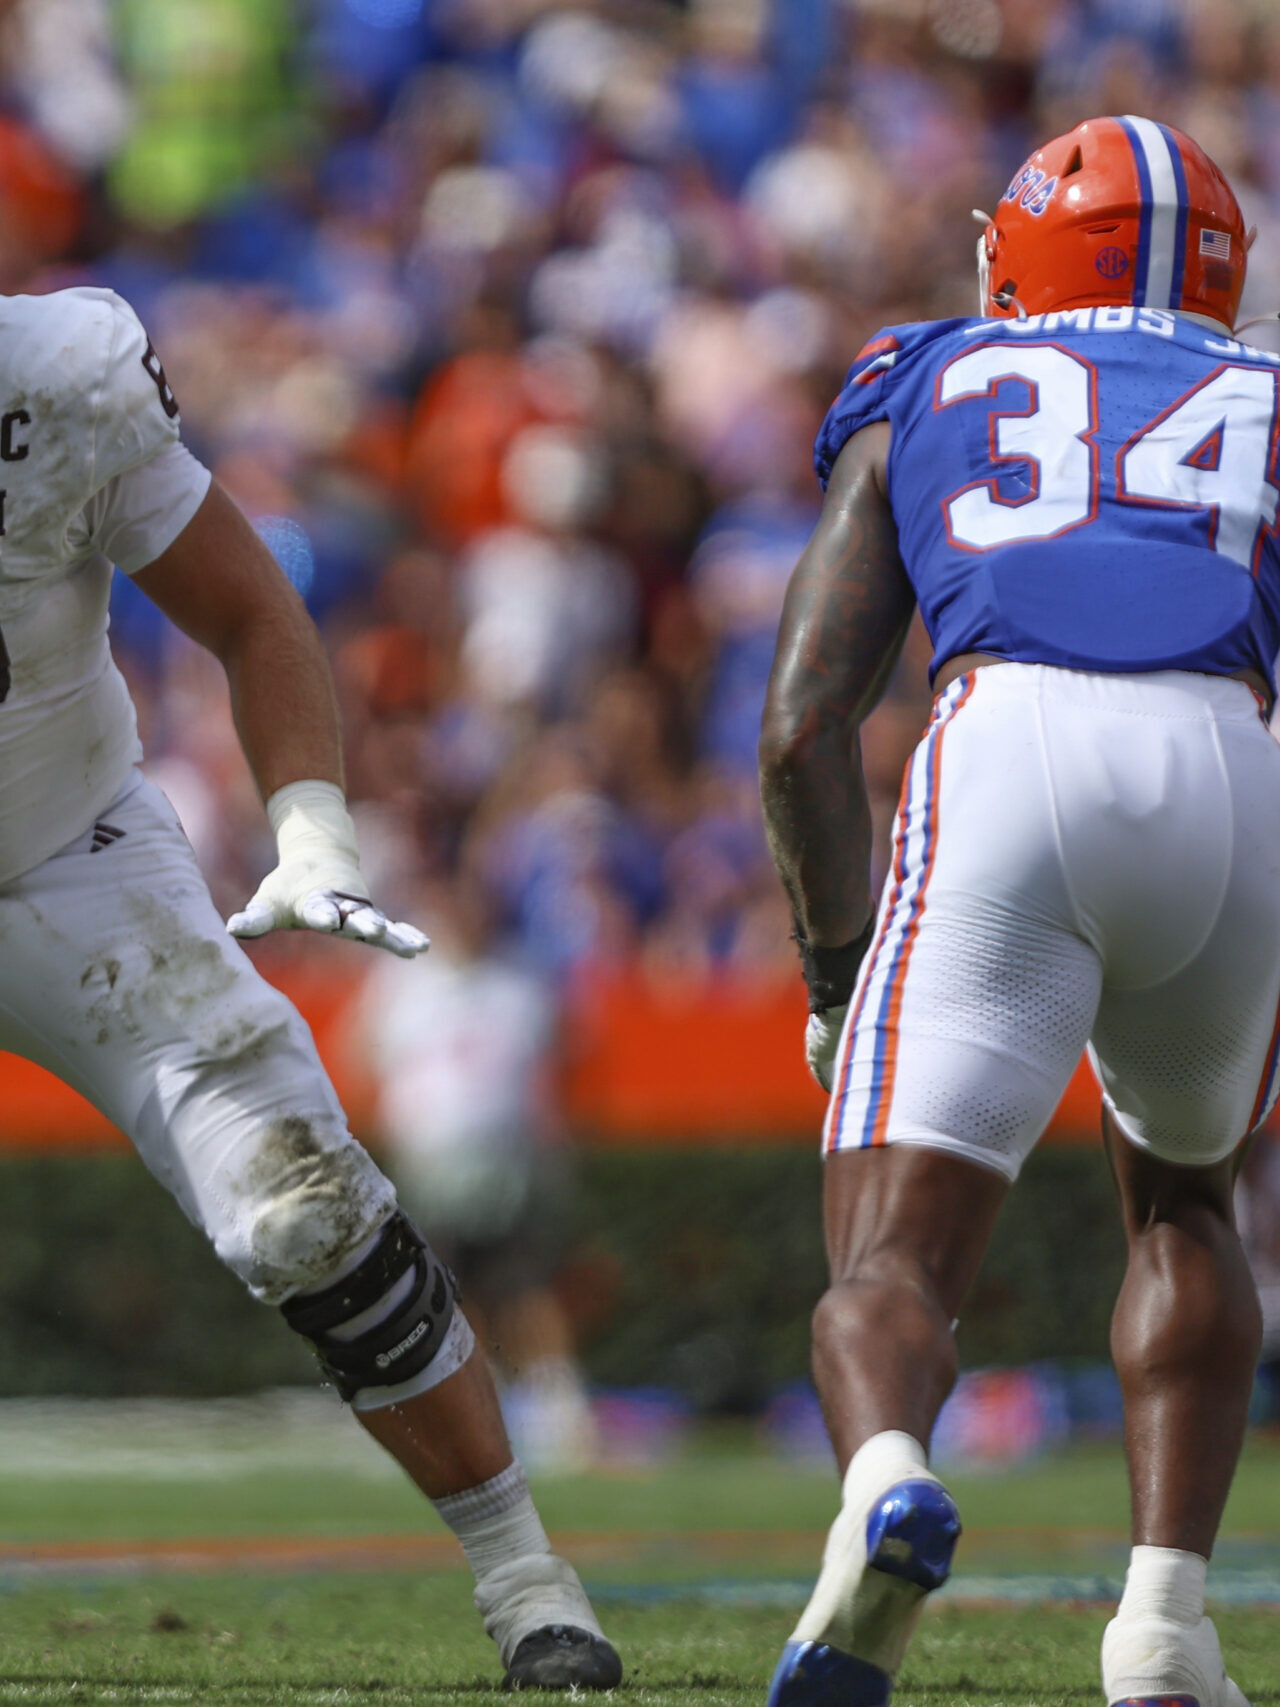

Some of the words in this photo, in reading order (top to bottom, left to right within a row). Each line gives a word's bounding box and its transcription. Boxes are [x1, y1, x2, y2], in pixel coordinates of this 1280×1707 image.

[1095, 246, 1129, 279] SEC
[0, 408, 32, 463] C
[933, 340, 1280, 580] 34
[388, 1320, 430, 1362] BREG
